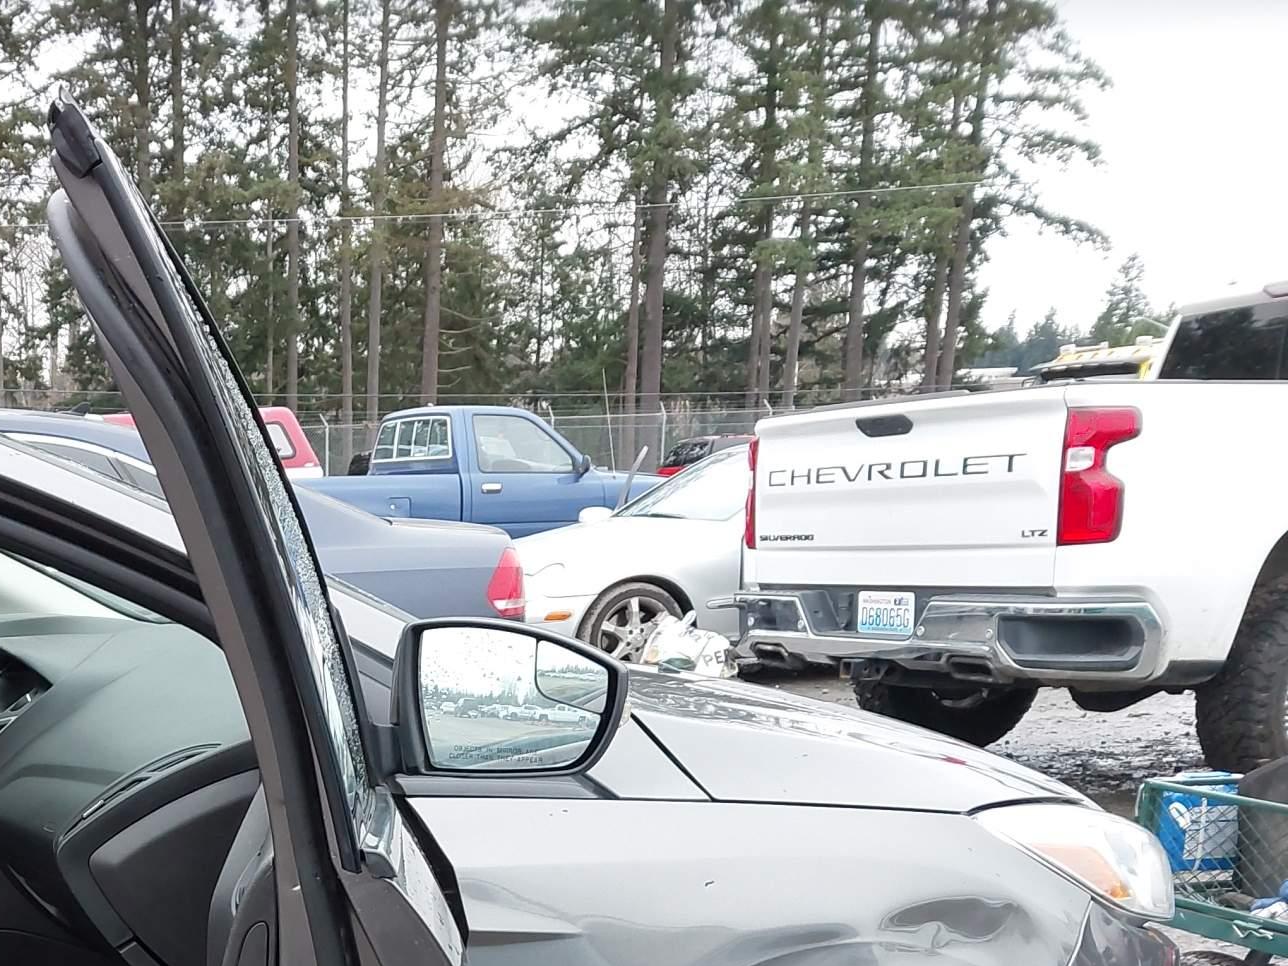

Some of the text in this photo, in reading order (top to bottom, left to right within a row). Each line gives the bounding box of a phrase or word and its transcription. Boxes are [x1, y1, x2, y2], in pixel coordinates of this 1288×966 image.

[768, 453, 1028, 487] CHEVROLET
[759, 533, 815, 542] SILVERADO
[1021, 529, 1048, 538] LTZ
